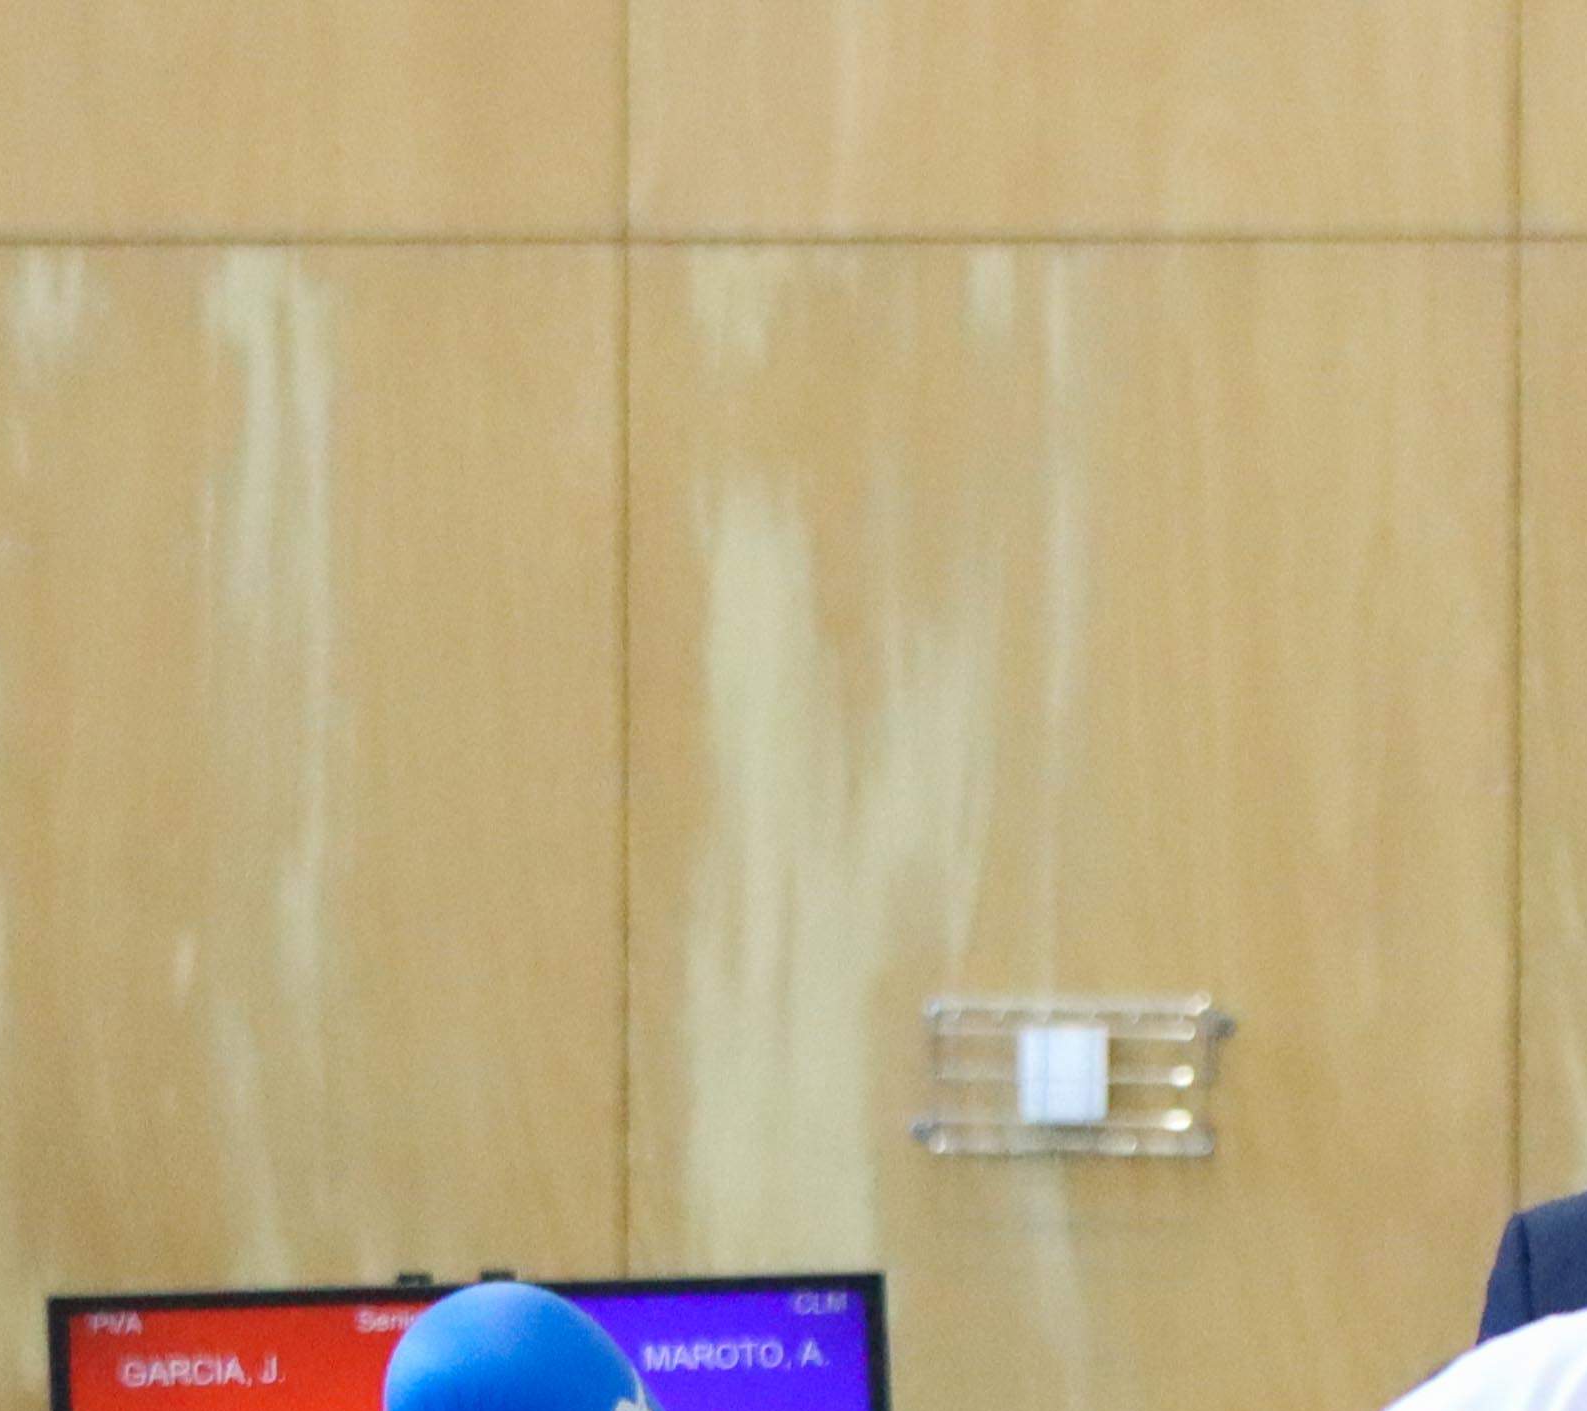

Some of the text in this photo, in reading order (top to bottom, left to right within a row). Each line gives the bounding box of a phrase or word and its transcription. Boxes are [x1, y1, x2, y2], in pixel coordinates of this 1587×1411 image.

[354, 1304, 417, 1335] Seni
[120, 1353, 253, 1389] GARCIA,
[642, 1336, 792, 1373] MAROTO,
